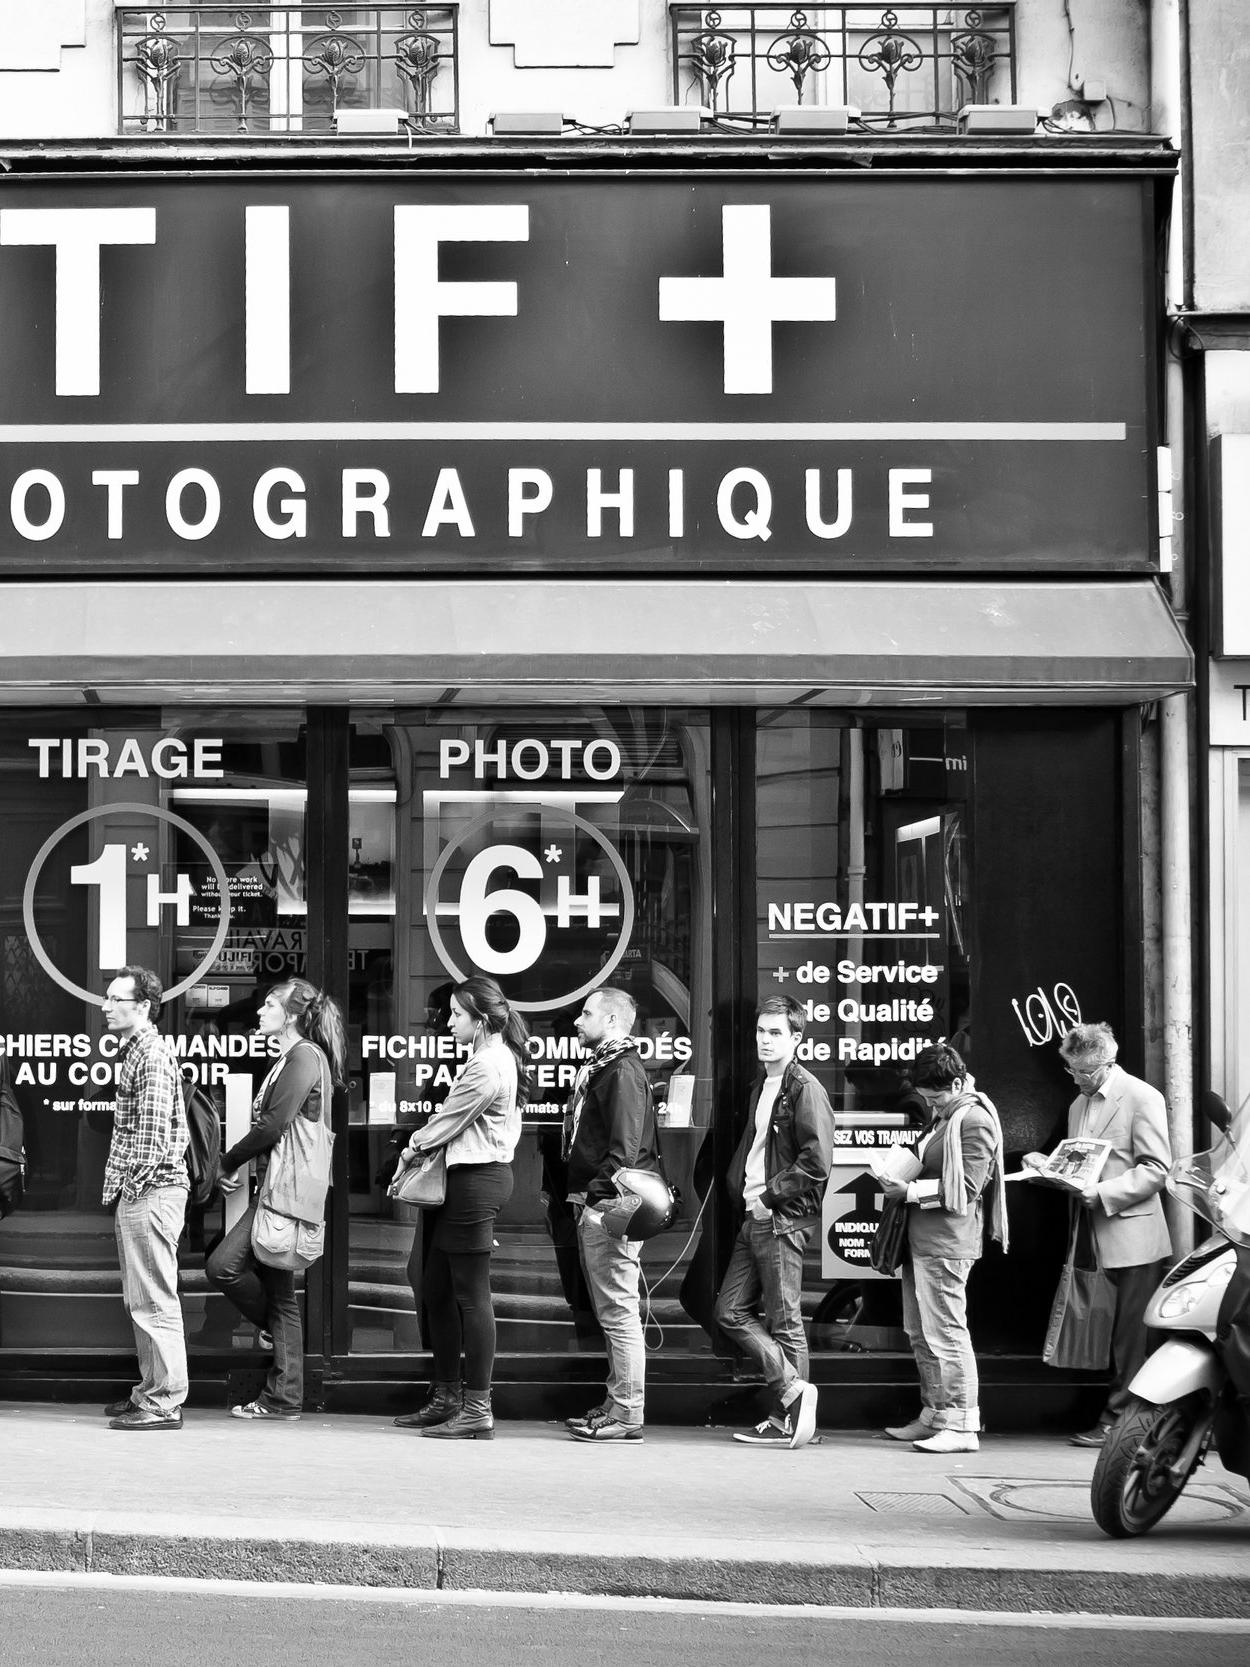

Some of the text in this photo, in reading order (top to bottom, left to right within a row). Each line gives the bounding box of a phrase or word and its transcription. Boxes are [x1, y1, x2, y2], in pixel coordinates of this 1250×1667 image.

[28, 737, 224, 779] TIRAGE
[439, 738, 621, 780] PHOTO
[768, 902, 940, 932] NEGATIF+
[796, 960, 831, 984] de
[837, 960, 939, 984] Service
[838, 998, 934, 1023] Qualité
[796, 1037, 831, 1061] de
[15, 1062, 57, 1086] AU
[52, 1101, 76, 1112] sur
[400, 1101, 432, 1113] 8x10
[855, 1129, 875, 1145] VOS
[838, 1238, 865, 1247] NOM
